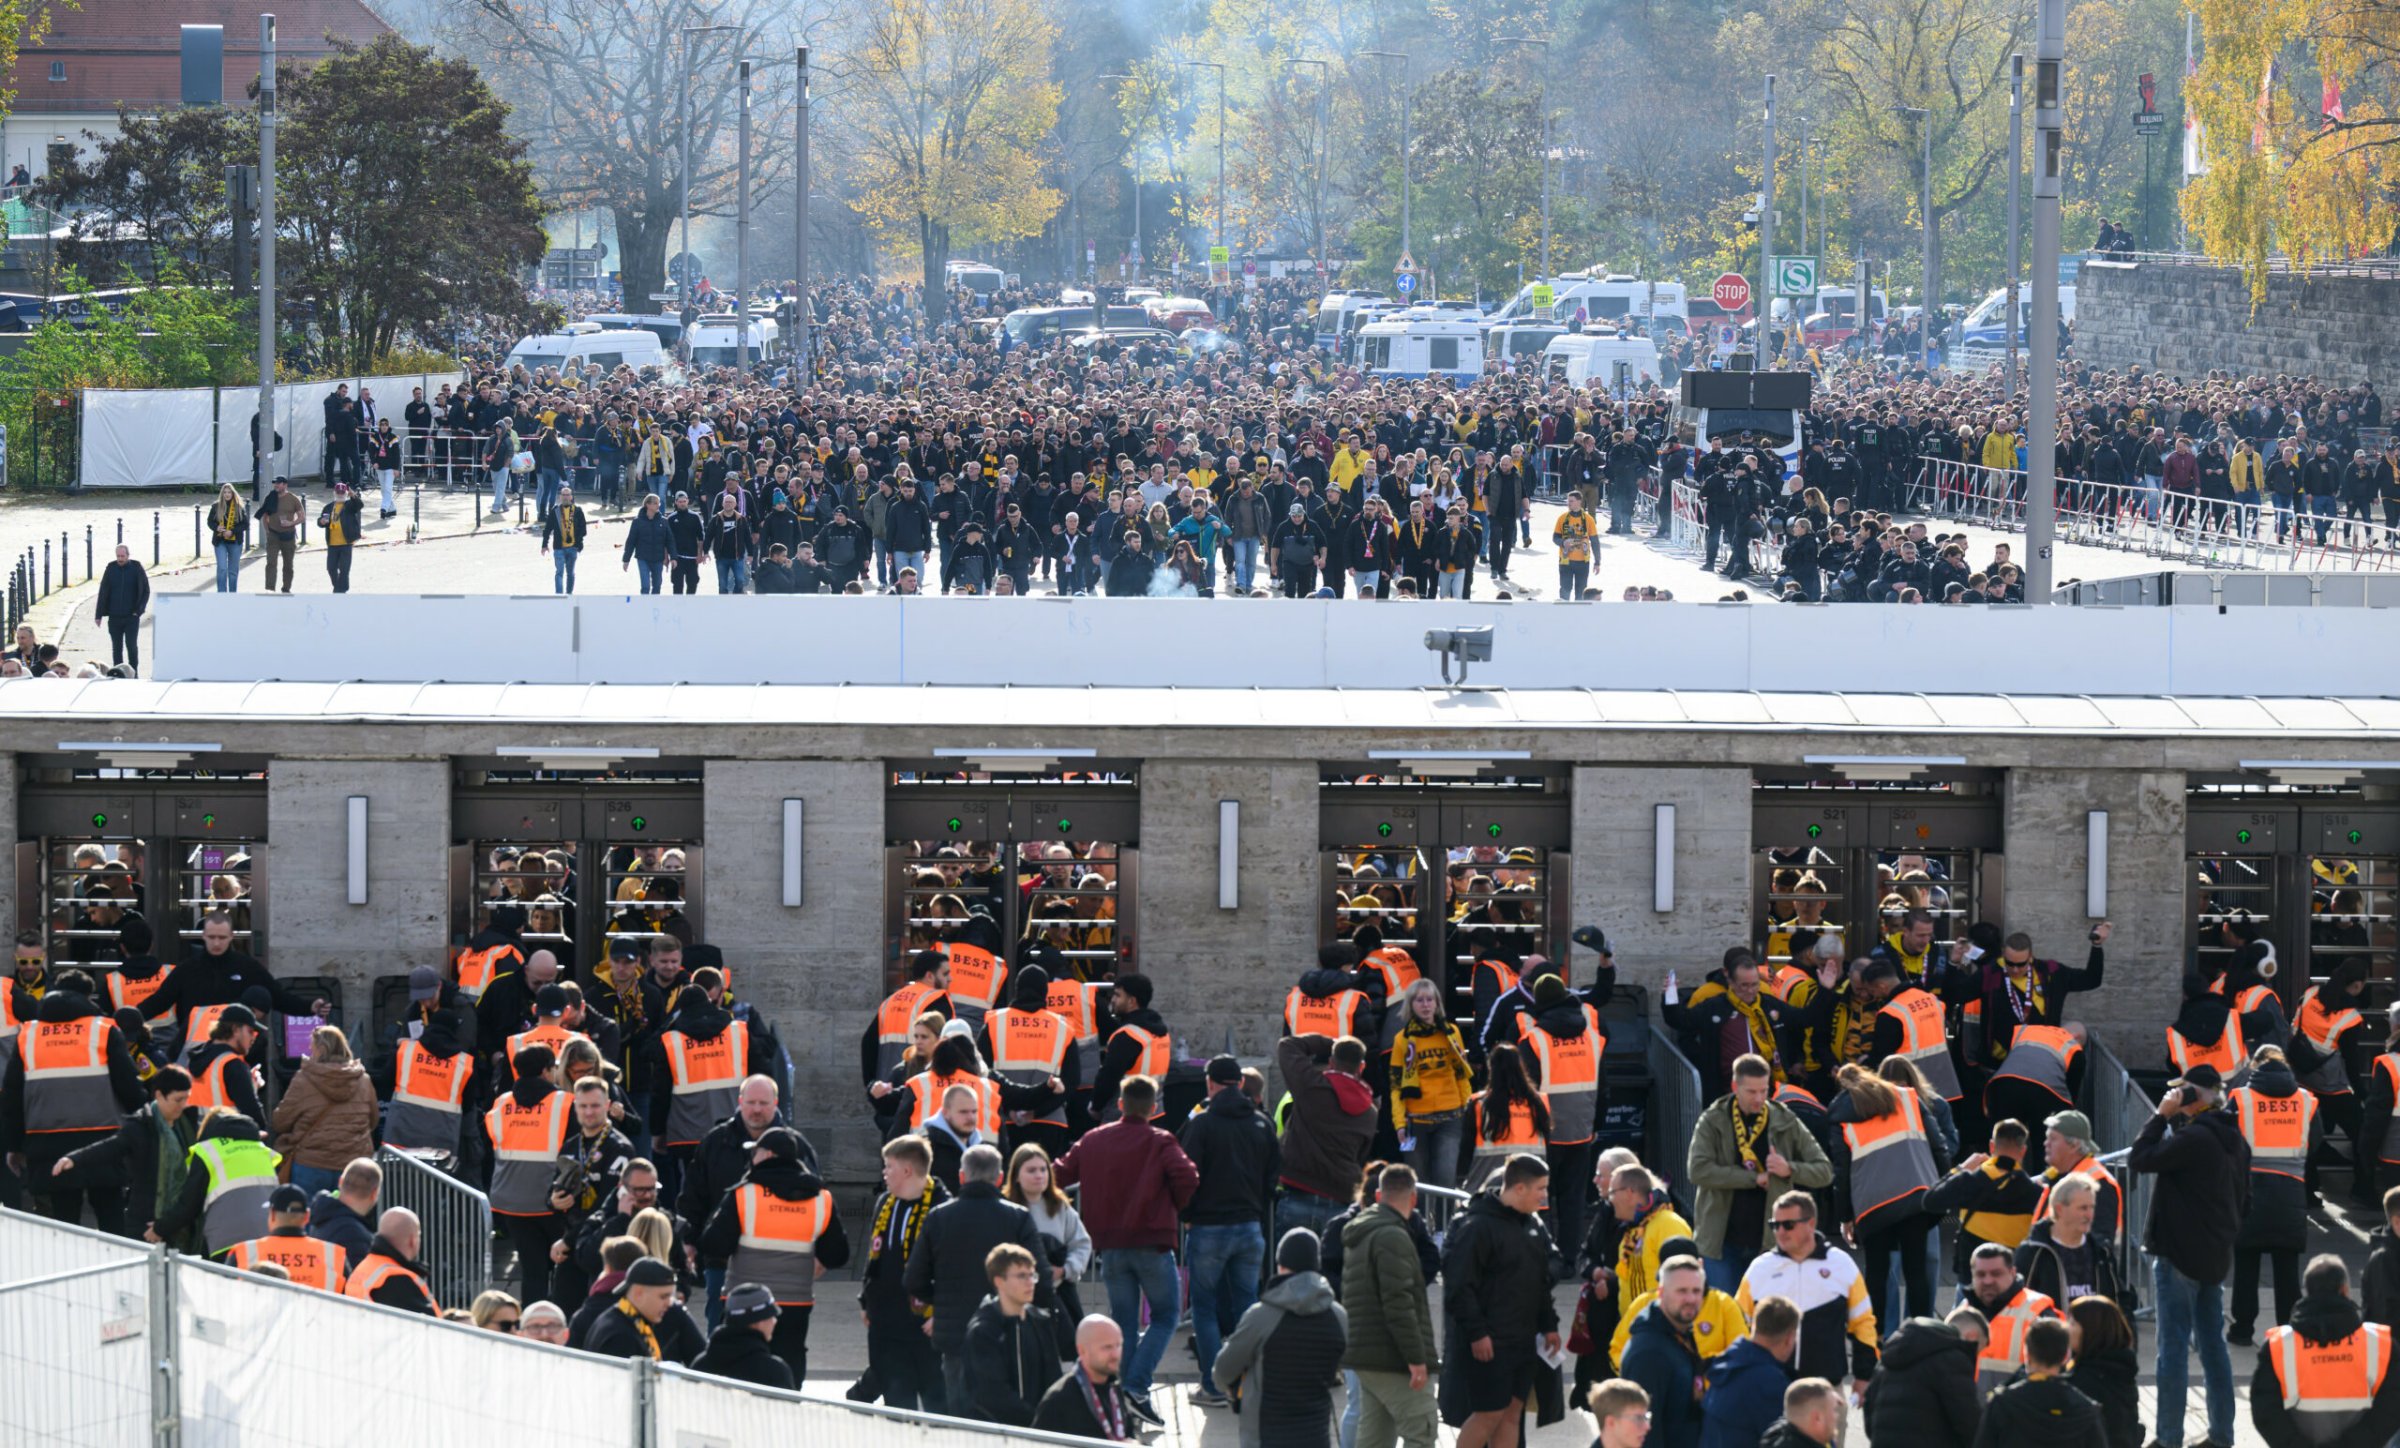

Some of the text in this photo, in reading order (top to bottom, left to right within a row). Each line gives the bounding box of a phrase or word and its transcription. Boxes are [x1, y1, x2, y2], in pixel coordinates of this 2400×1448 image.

[1716, 284, 1746, 299] STOP
[56, 302, 122, 315] POLEI
[608, 801, 631, 812] S26
[962, 802, 986, 814] S25
[1035, 803, 1058, 814] S24
[1392, 807, 1416, 818] S23
[1823, 809, 1846, 820] S21
[1893, 809, 1917, 820] S20
[2251, 814, 2275, 825] S19
[953, 953, 991, 971] BEST
[956, 968, 986, 980] STEWARD
[1047, 995, 1075, 1007] EST
[1301, 995, 1336, 1009] BEST
[1907, 996, 1934, 1013] BEST
[287, 1015, 321, 1026] BEST
[1011, 1016, 1051, 1029] BEST
[42, 1024, 84, 1036] BEST
[1016, 1031, 1047, 1039] STEWARD
[693, 1050, 725, 1061] STEWARD
[2192, 1045, 2223, 1058] STEWARD
[416, 1053, 453, 1069] BEST
[2258, 1100, 2299, 1113] BEST
[768, 1204, 807, 1215] STEWARD
[2311, 1352, 2354, 1365] STEWARD
